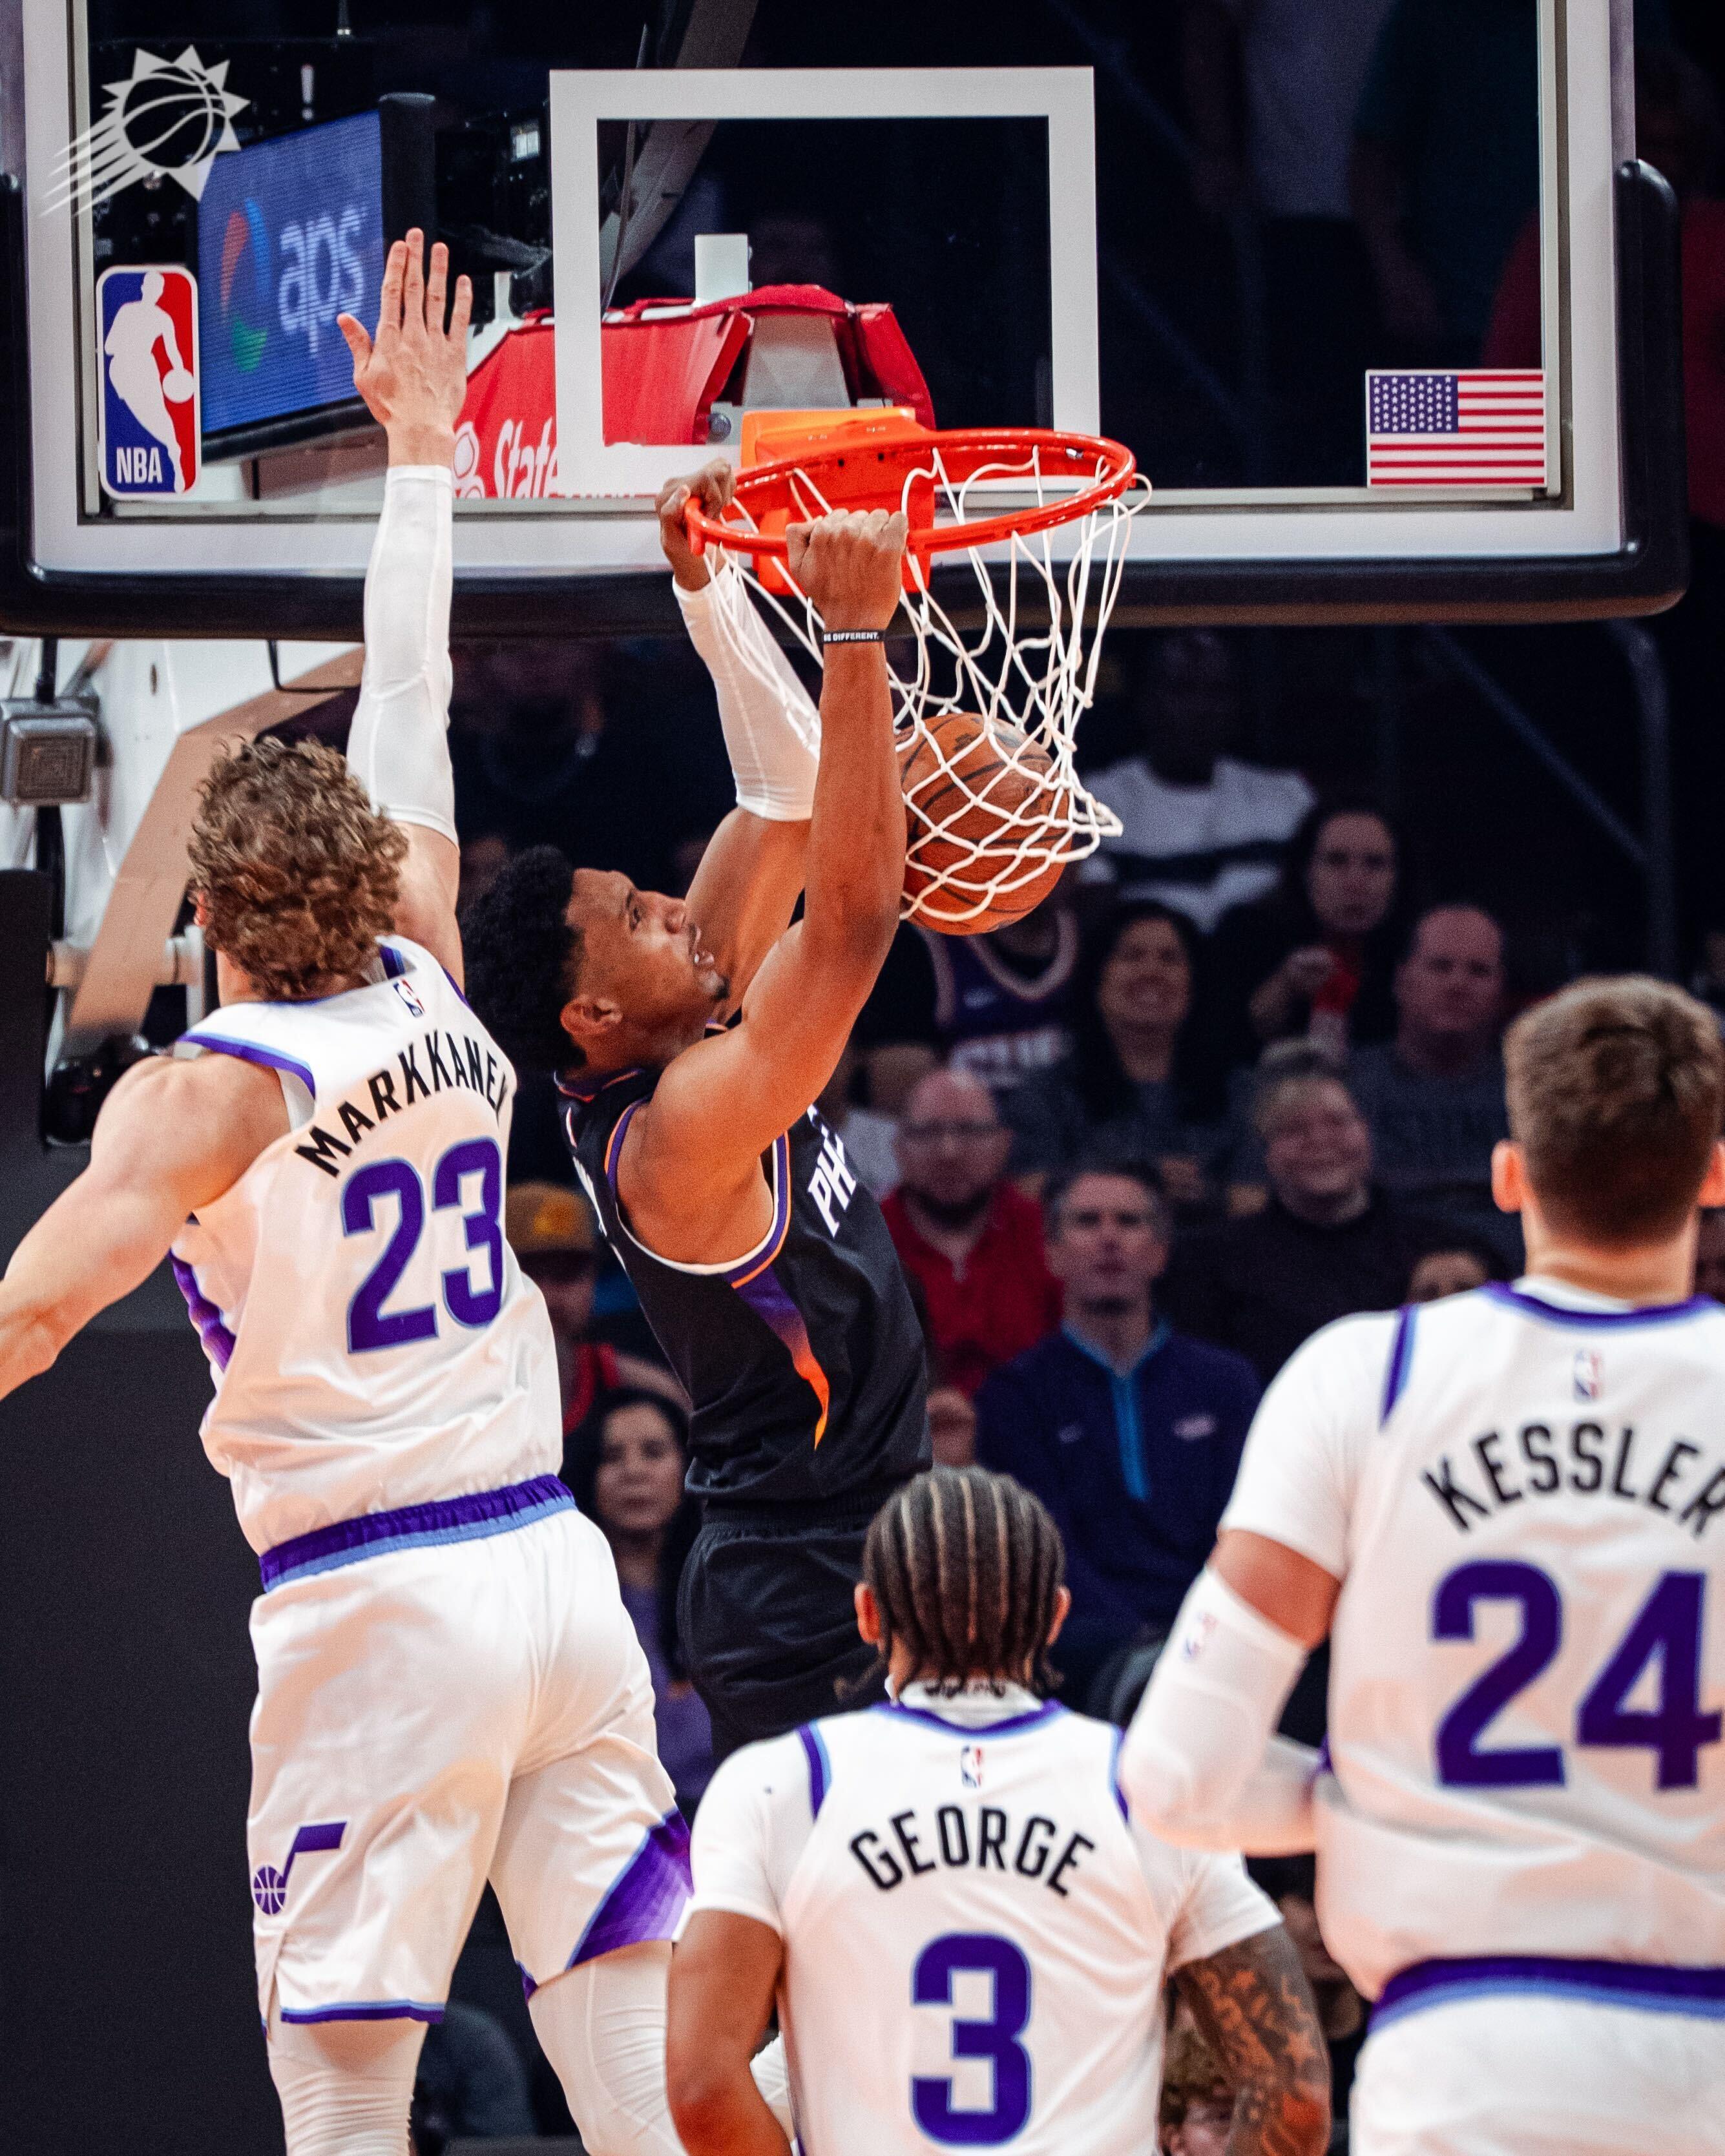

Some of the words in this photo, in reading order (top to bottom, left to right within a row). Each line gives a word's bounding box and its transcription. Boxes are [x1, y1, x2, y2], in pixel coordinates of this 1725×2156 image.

[279, 205, 364, 357] aps
[116, 447, 162, 483] NBA
[340, 1135, 503, 1354] 23
[1421, 1422, 1725, 1536] KESSLER
[1429, 1558, 1724, 1791] 24
[848, 1803, 1096, 1898] GEORGE
[910, 1931, 1033, 2148] 3
